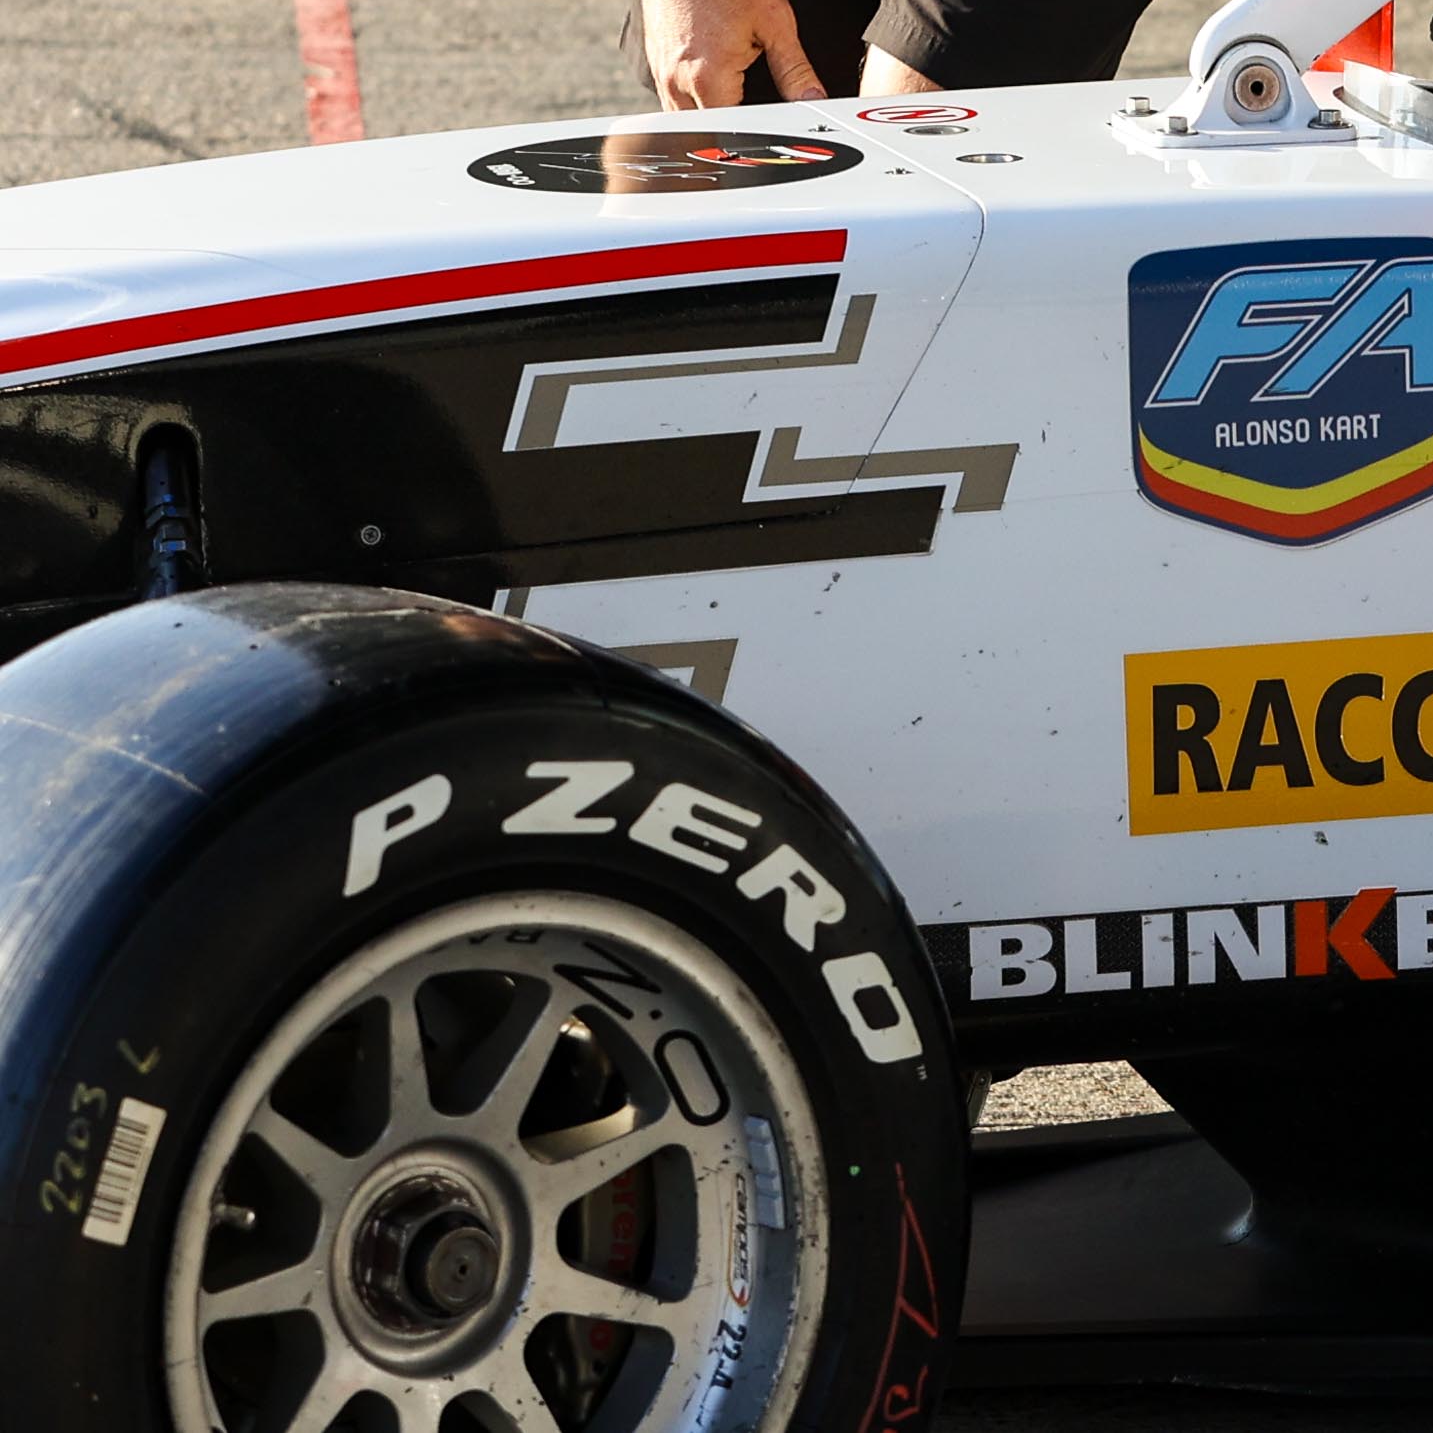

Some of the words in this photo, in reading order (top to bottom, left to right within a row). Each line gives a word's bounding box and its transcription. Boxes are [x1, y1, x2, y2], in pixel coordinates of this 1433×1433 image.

[1215, 418, 1310, 448] ALONSO
[1320, 413, 1381, 441] KART
[343, 773, 453, 897] P
[501, 761, 923, 1064] ZERO
